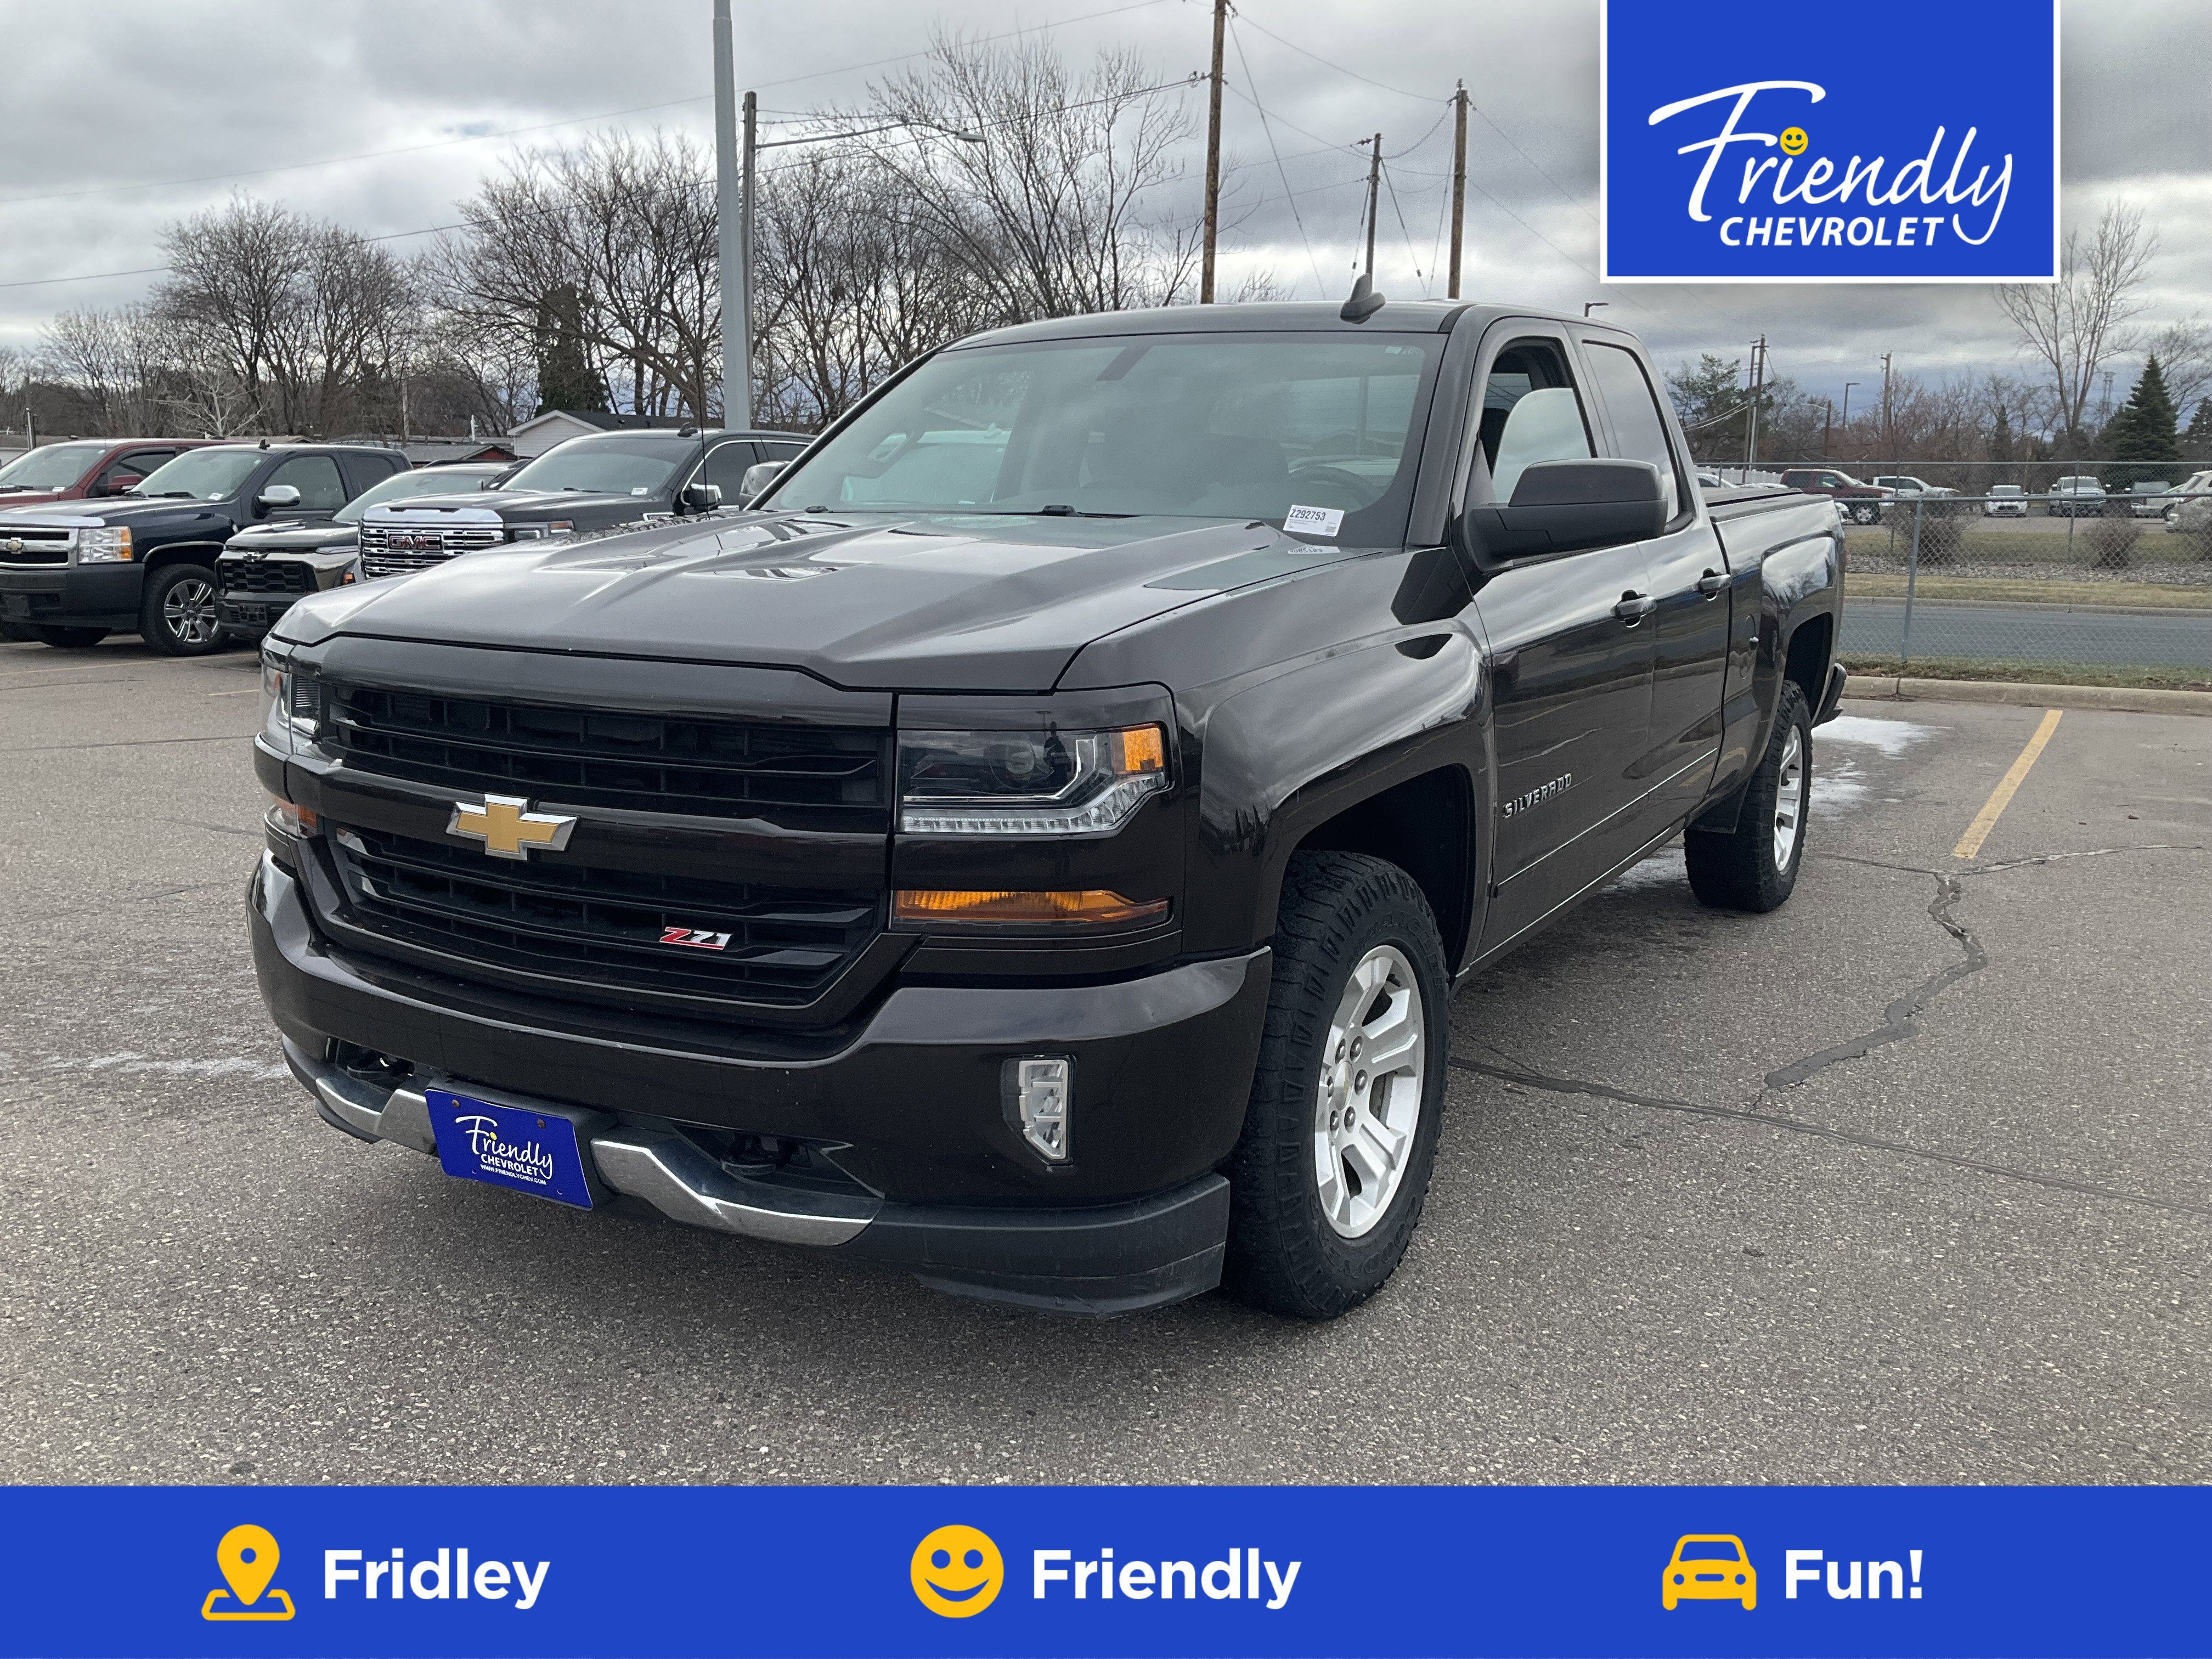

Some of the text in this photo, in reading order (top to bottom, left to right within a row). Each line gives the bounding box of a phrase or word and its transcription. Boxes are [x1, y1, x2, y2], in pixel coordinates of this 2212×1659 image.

[1289, 509, 1327, 521] Z292753
[388, 535, 440, 549] GMC
[1502, 772, 1572, 820] SILVERADO
[659, 926, 732, 950] Z71
[455, 1115, 553, 1180] Friendly
[479, 1164, 547, 1186] WWW.FRIENDLYCHEV.COM
[480, 1153, 538, 1177] CHEVROLET
[1309, 1193, 1417, 1279] GOODYEAR
